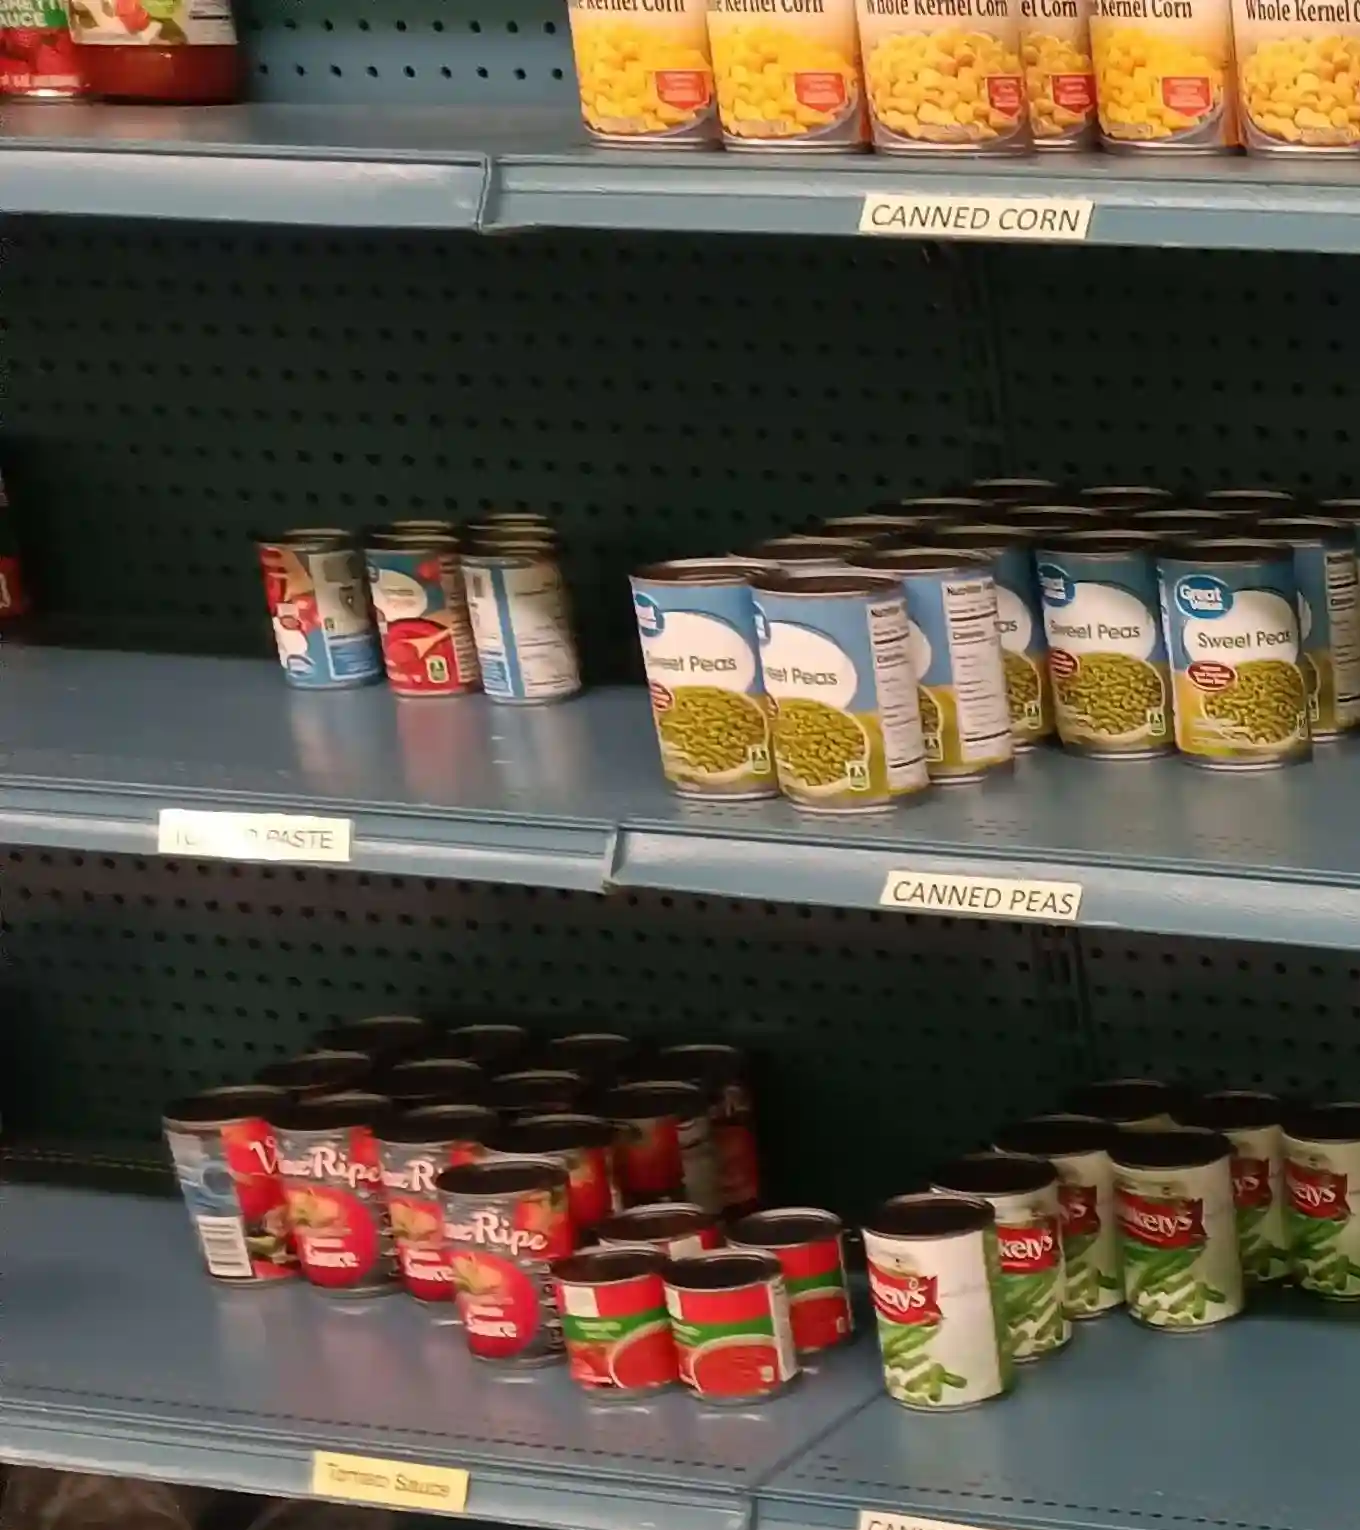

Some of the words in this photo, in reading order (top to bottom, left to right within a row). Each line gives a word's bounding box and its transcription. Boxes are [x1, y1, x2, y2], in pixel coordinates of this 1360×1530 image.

[0, 12, 47, 28] AUCE
[1151, 0, 1194, 19] Corn
[1246, 0, 1291, 22] Whole
[1295, 0, 1351, 23] Kernel
[870, 203, 991, 230] CANNED
[998, 207, 1081, 233] CORN
[1097, 623, 1141, 640] Peas
[1197, 630, 1252, 650] Sweet
[1256, 630, 1293, 647] Peas
[689, 655, 738, 673] Peas
[765, 665, 788, 683] eet
[792, 667, 838, 687] Peas
[266, 828, 334, 850] PASTE
[892, 880, 1002, 909] CANNED
[1008, 889, 1075, 915] PEAS
[313, 1144, 382, 1189] Ripe
[475, 1212, 549, 1256] Ripe
